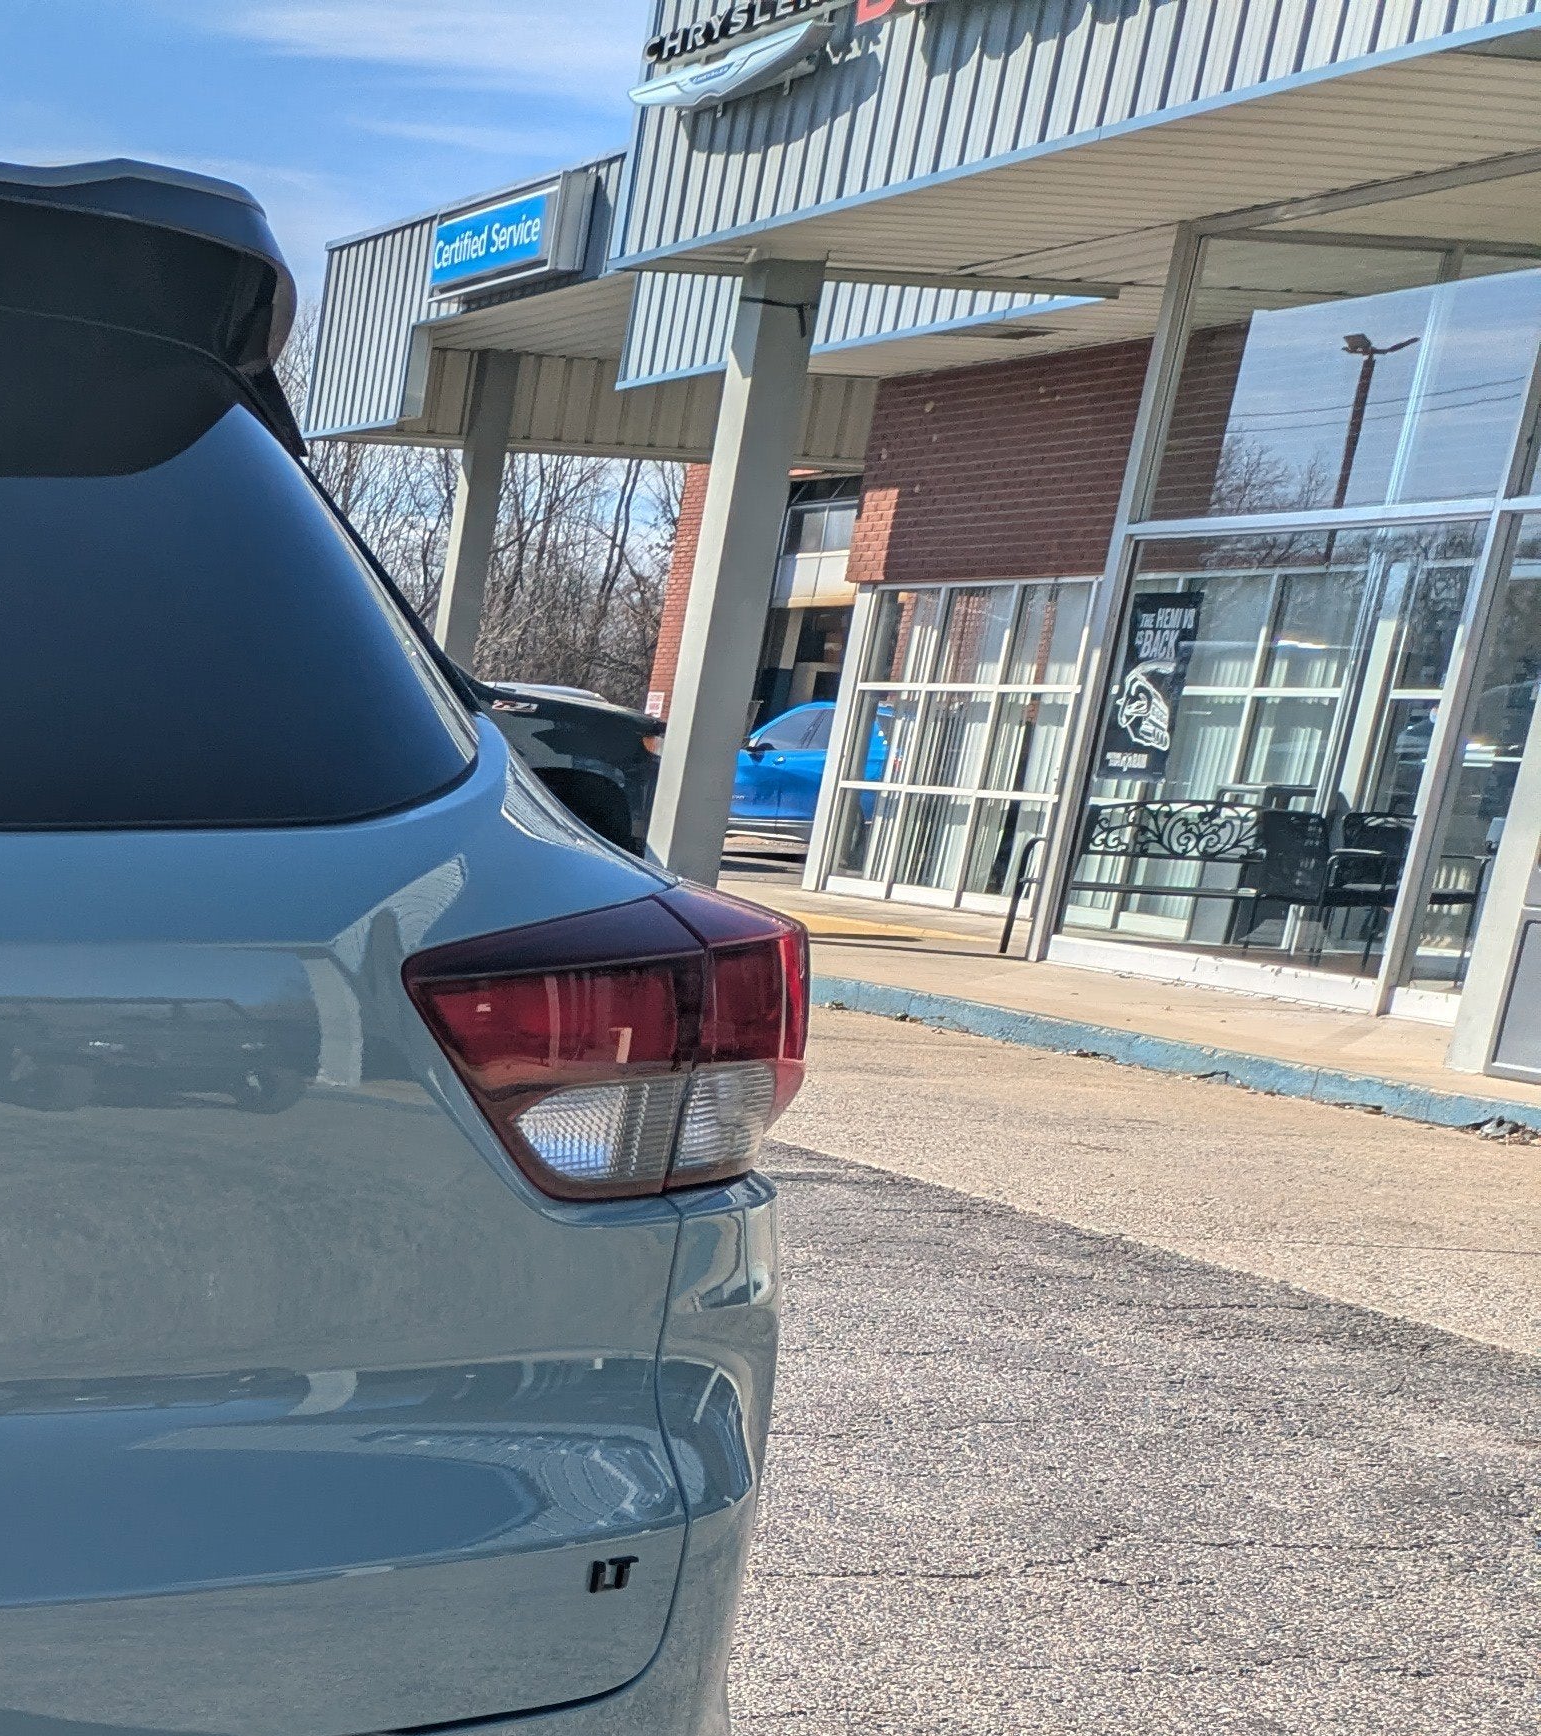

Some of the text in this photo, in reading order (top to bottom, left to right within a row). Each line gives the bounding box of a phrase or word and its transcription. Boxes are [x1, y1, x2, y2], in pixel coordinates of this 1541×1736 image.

[643, 0, 821, 64] CHRYSLE
[434, 214, 541, 270] Certified Service
[1139, 613, 1156, 628] THE
[1156, 607, 1184, 629] HEMI
[1138, 629, 1180, 660] BACK
[589, 1555, 639, 1593] LT
